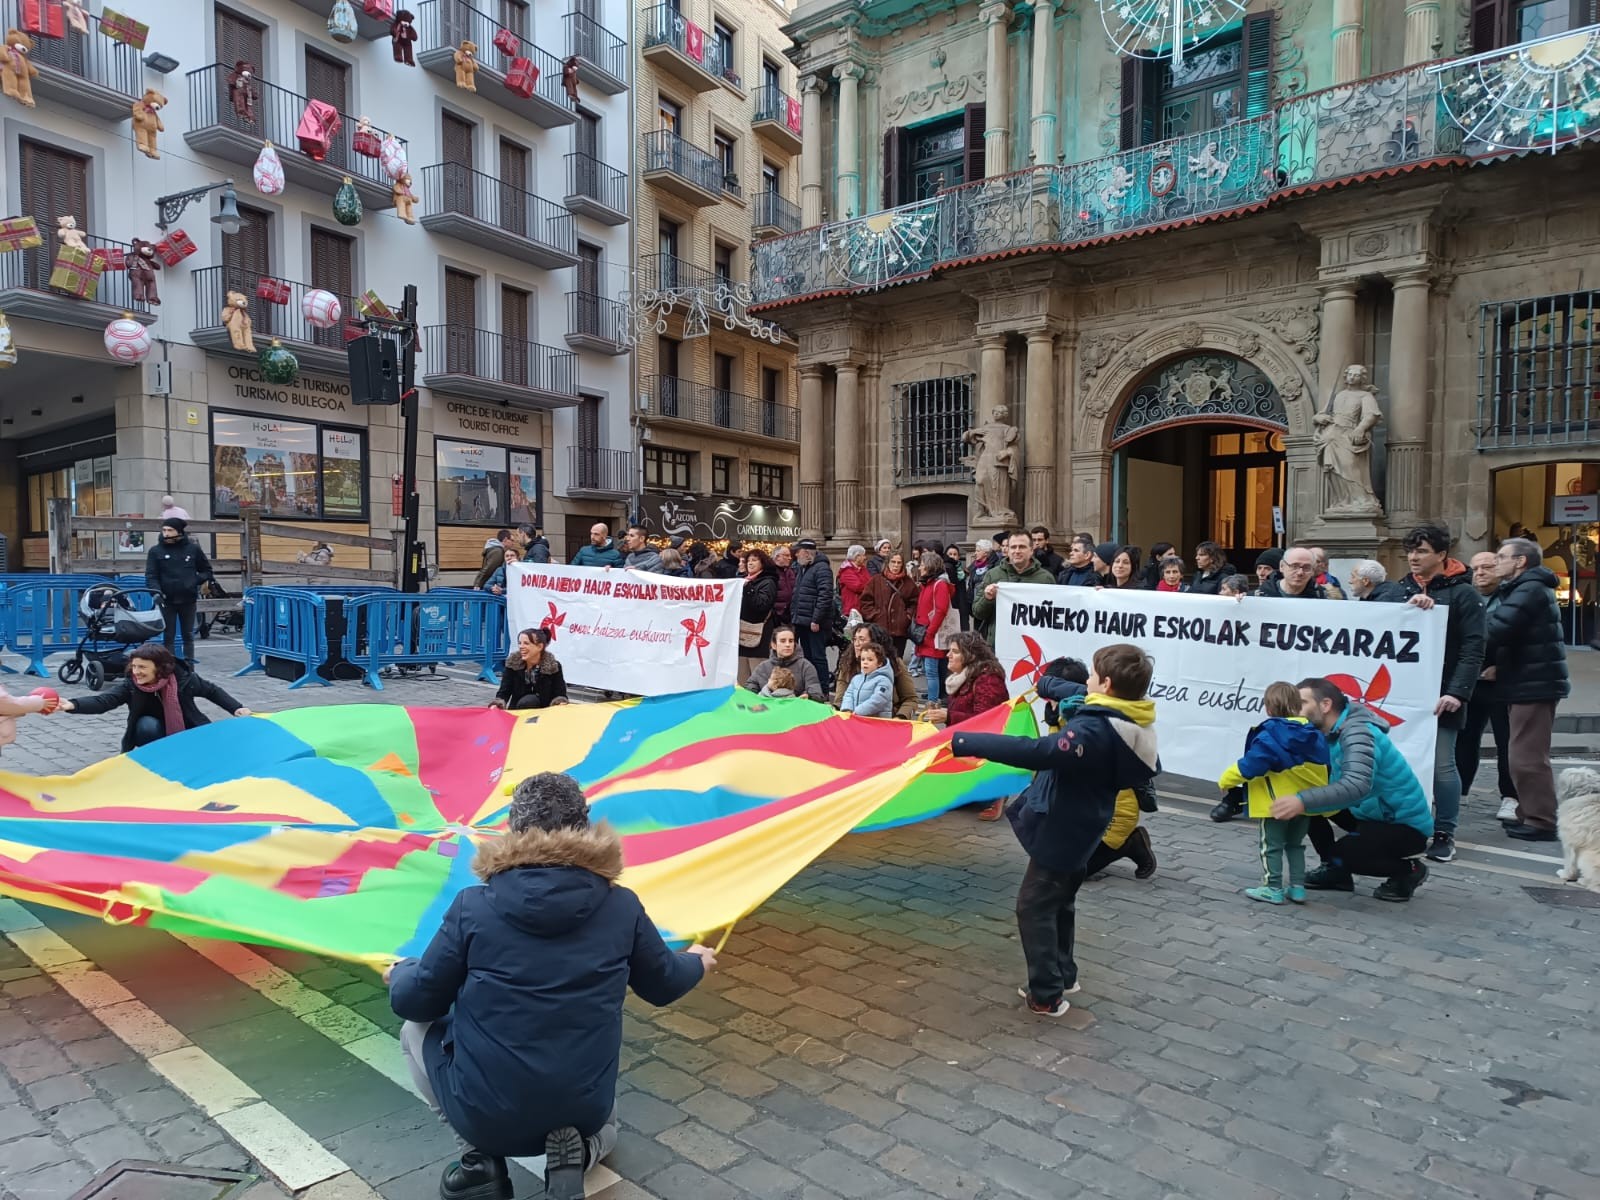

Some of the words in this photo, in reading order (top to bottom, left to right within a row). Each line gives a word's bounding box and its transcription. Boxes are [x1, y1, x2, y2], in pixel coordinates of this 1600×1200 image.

[234, 384, 289, 403] TURISMO
[291, 393, 346, 412] BULEGOA
[302, 378, 350, 396] TURISMO
[447, 401, 477, 417] OFFICE
[479, 407, 491, 418] DE
[492, 409, 529, 424] TOURISME
[458, 417, 490, 432] TOURIST
[492, 423, 520, 436] OFFICE
[583, 579, 612, 596] HAUR
[613, 582, 658, 601] ESKOLAK
[660, 583, 724, 602] EUSKARAZ
[1010, 599, 1090, 634] IRUÑEKO
[1094, 610, 1147, 638] HAUR
[1153, 615, 1251, 647] ESKOLAK
[1259, 622, 1420, 663] EUSKARAZ
